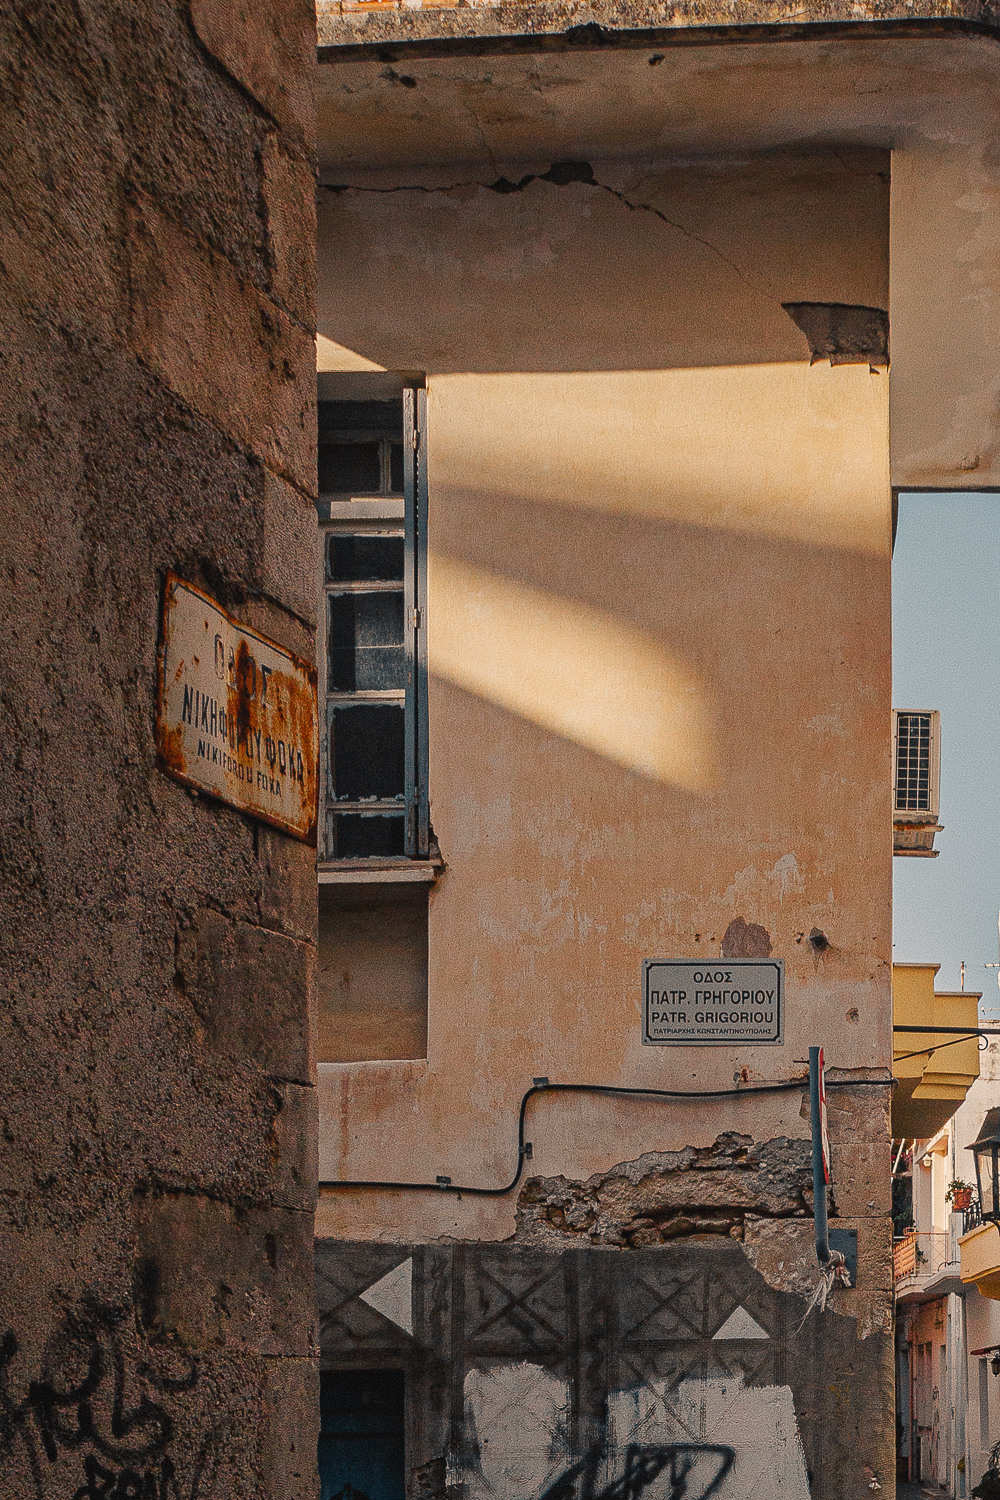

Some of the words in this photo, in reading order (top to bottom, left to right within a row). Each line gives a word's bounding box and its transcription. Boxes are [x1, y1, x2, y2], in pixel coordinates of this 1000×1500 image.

[198, 739, 253, 784] NIKIFOROU
[693, 971, 732, 983] ΟΔΟΣ
[651, 990, 690, 1004] ΠΑΤΡ.
[695, 990, 774, 1004] ΓΡΗΓΟΡΙΟΥ
[652, 1012, 690, 1023] PATR.
[695, 1012, 773, 1023] GRIGORIOU
